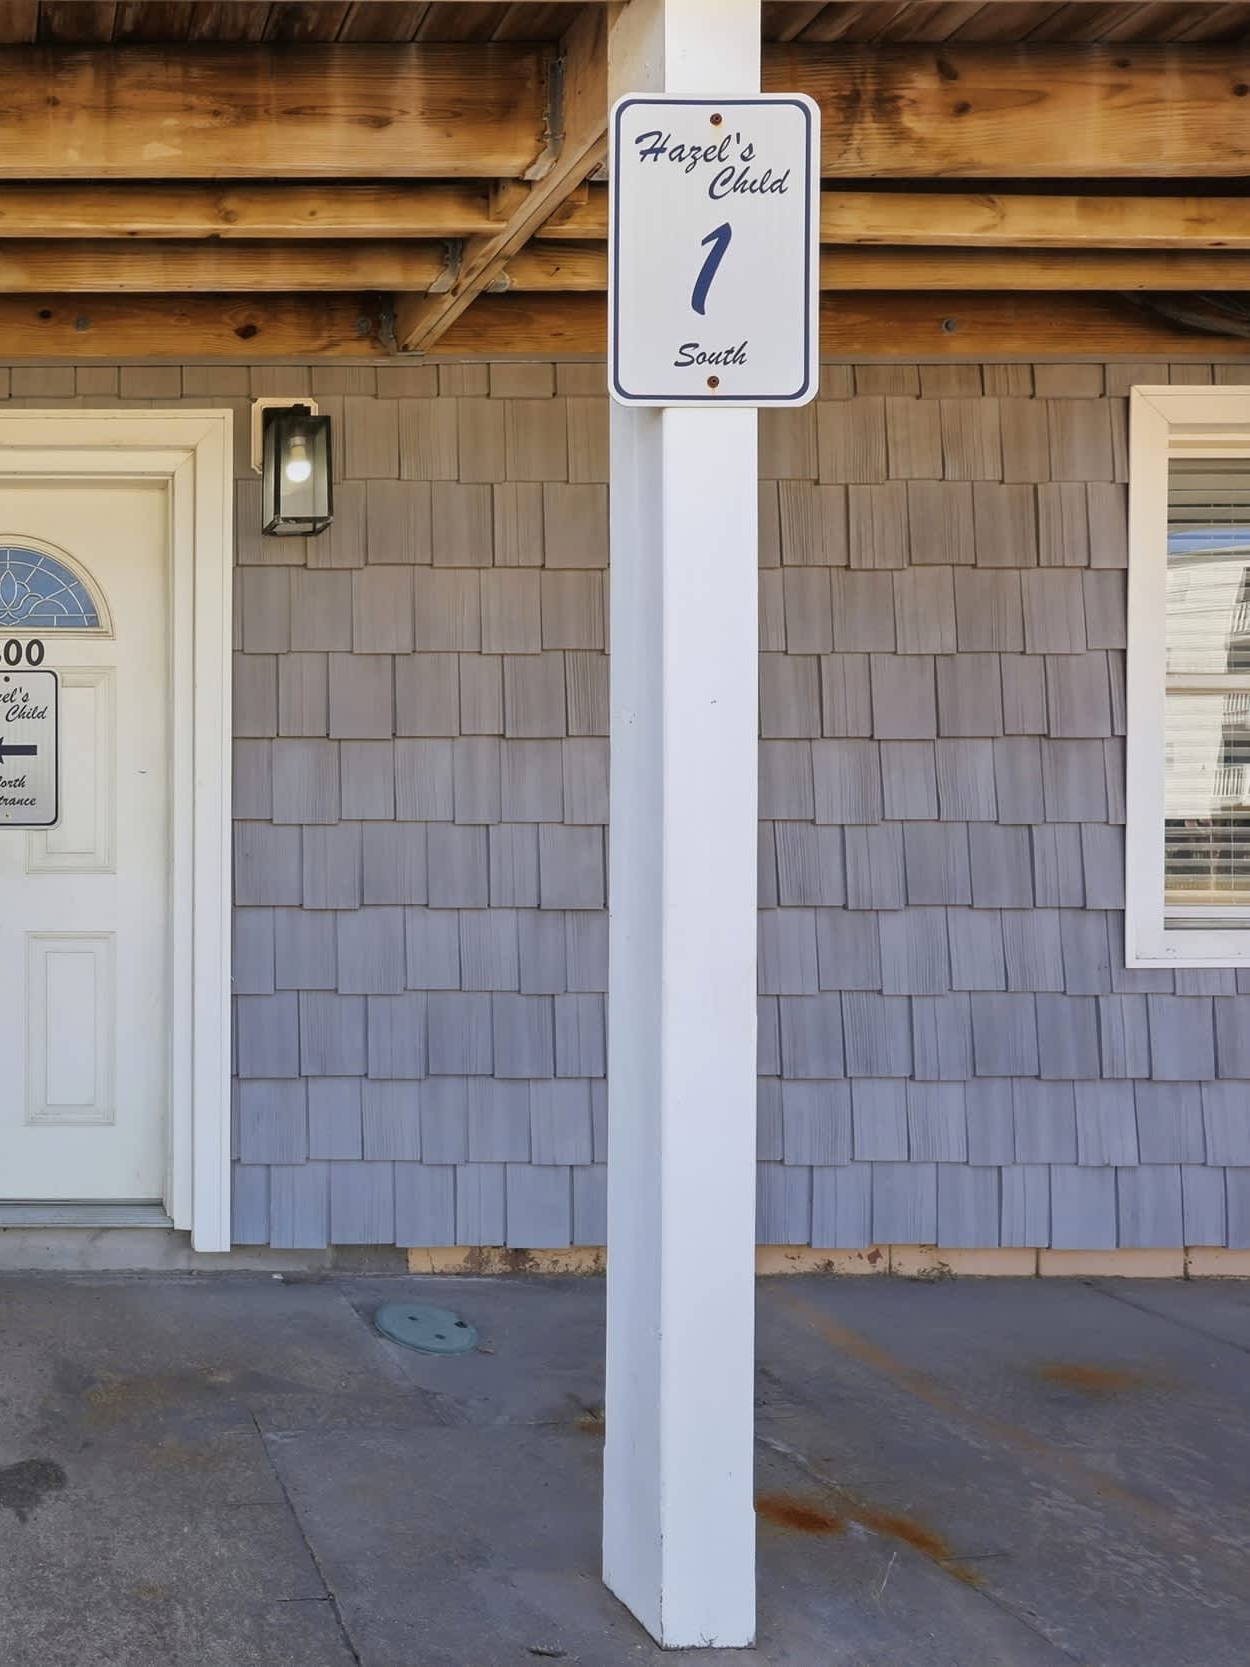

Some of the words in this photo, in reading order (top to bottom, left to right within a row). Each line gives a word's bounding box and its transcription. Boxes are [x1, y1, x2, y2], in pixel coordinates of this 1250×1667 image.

[635, 131, 755, 173] Hazel's
[707, 166, 791, 200] Child
[692, 223, 731, 315] 1
[674, 341, 748, 367] South
[6, 704, 48, 722] Child
